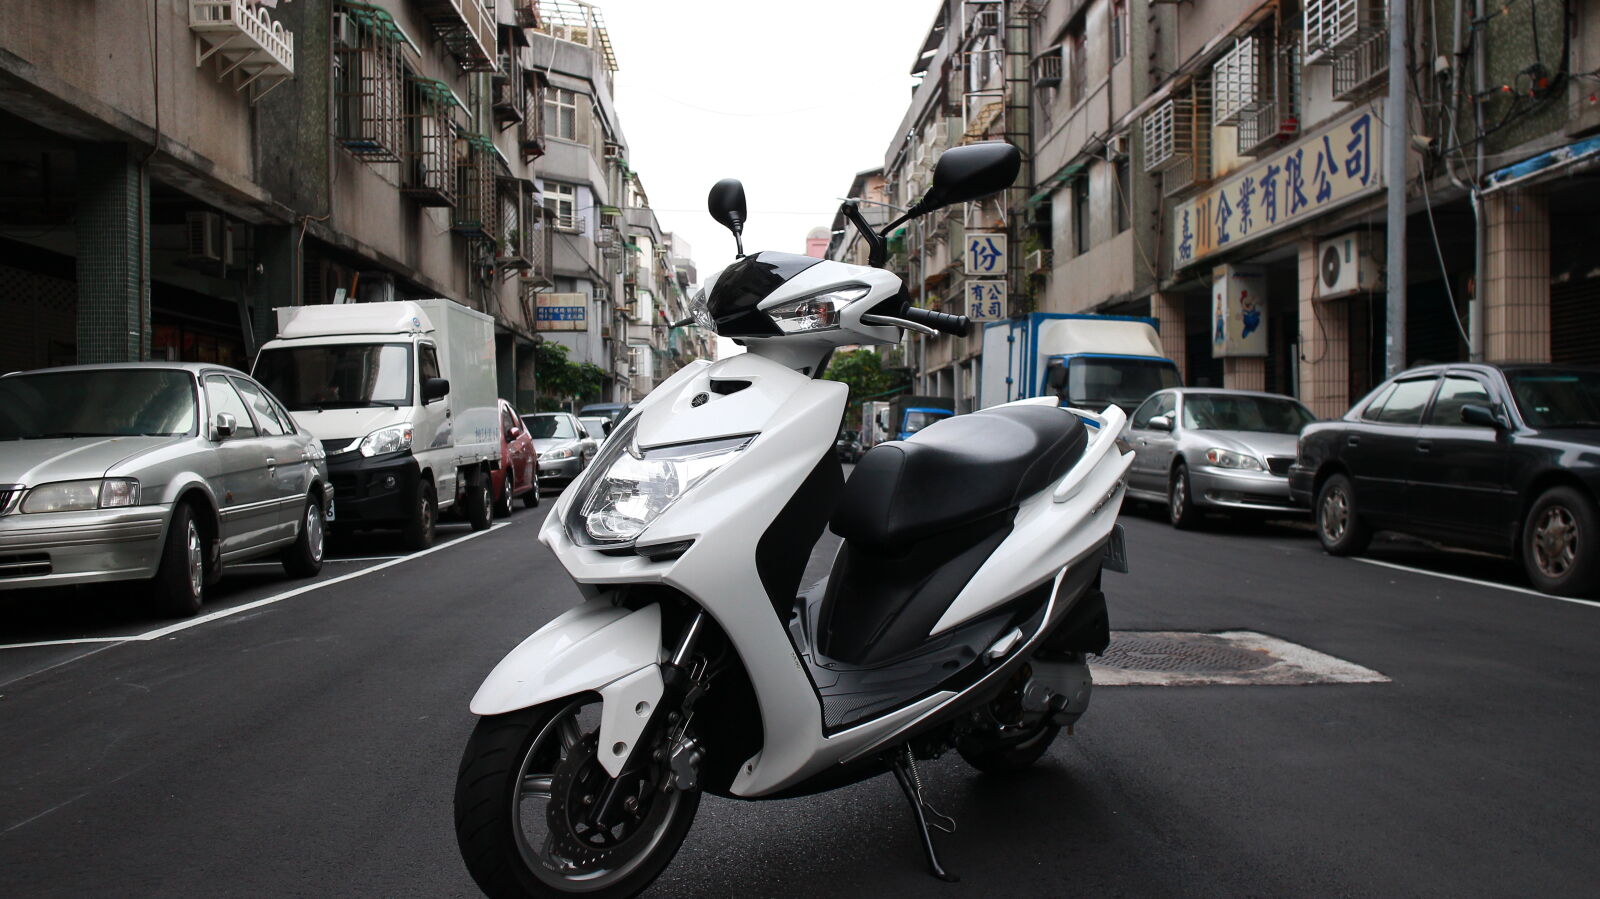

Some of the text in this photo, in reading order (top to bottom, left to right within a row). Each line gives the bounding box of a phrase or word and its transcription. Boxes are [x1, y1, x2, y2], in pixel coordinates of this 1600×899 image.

[1178, 113, 1372, 262] 嘉川企業有限公司
[970, 237, 1003, 272] 份
